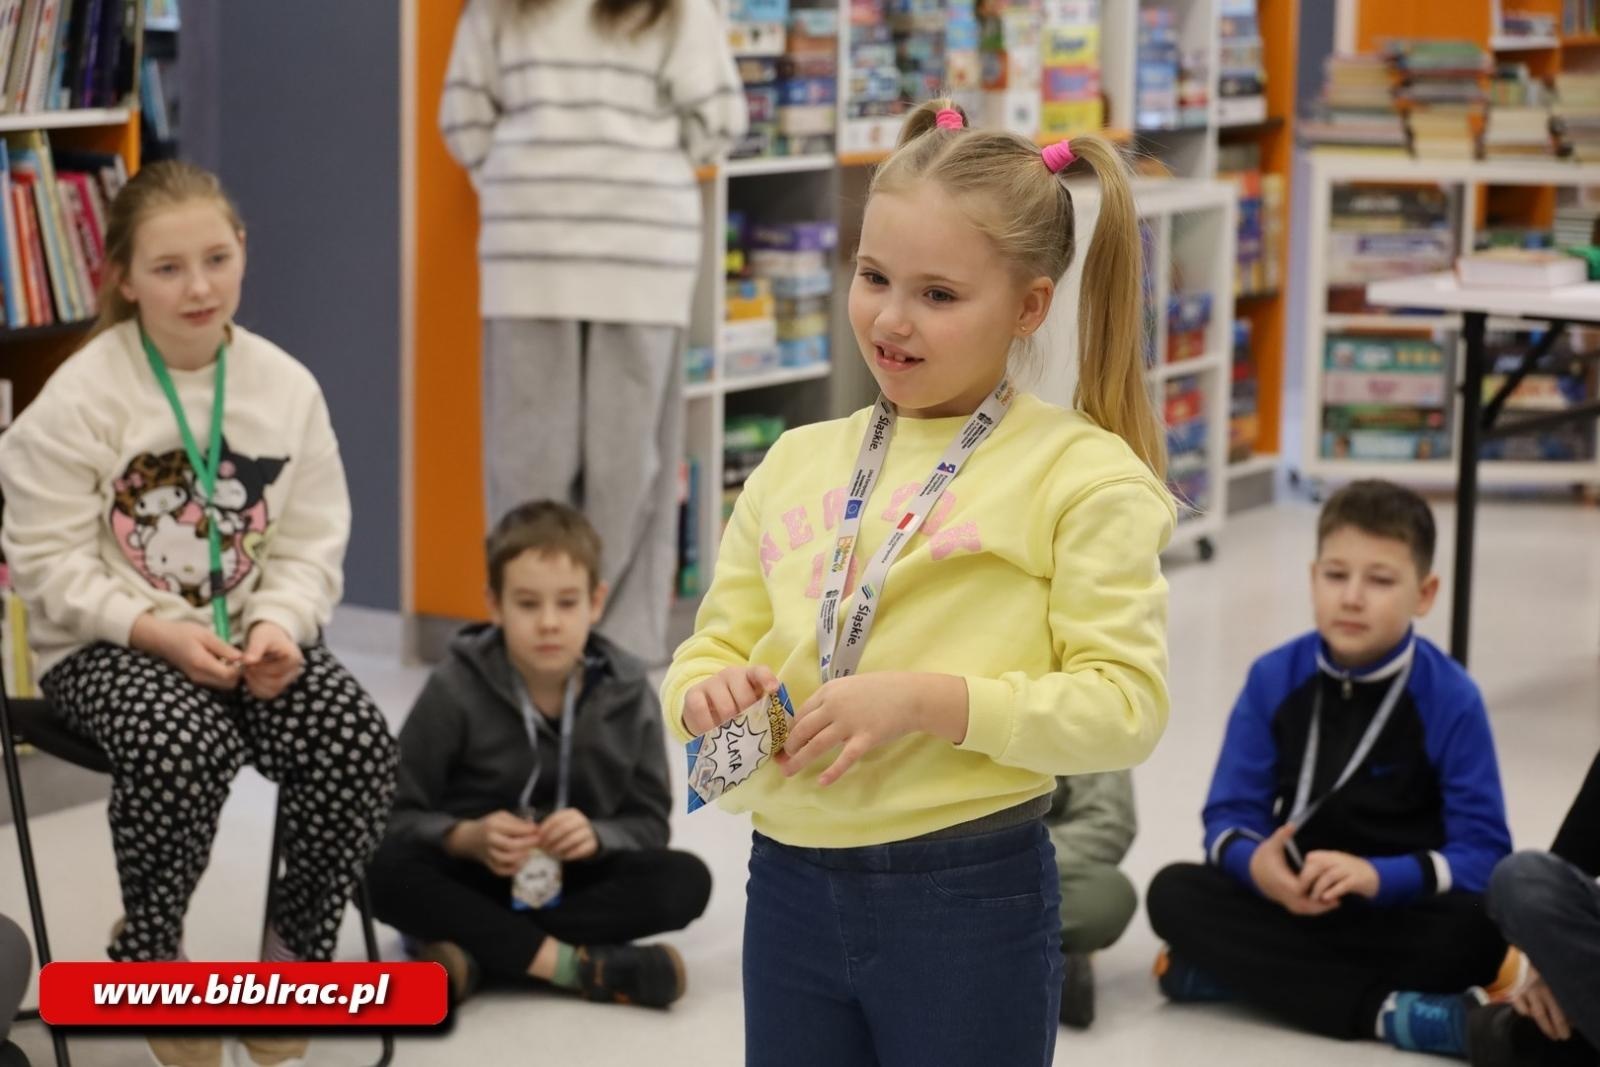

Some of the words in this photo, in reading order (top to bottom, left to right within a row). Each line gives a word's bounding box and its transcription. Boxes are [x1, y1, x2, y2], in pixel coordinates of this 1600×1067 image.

[869, 415, 891, 451] Śląskie.
[847, 604, 871, 647] Śląskie.
[726, 727, 743, 774] ZLATA
